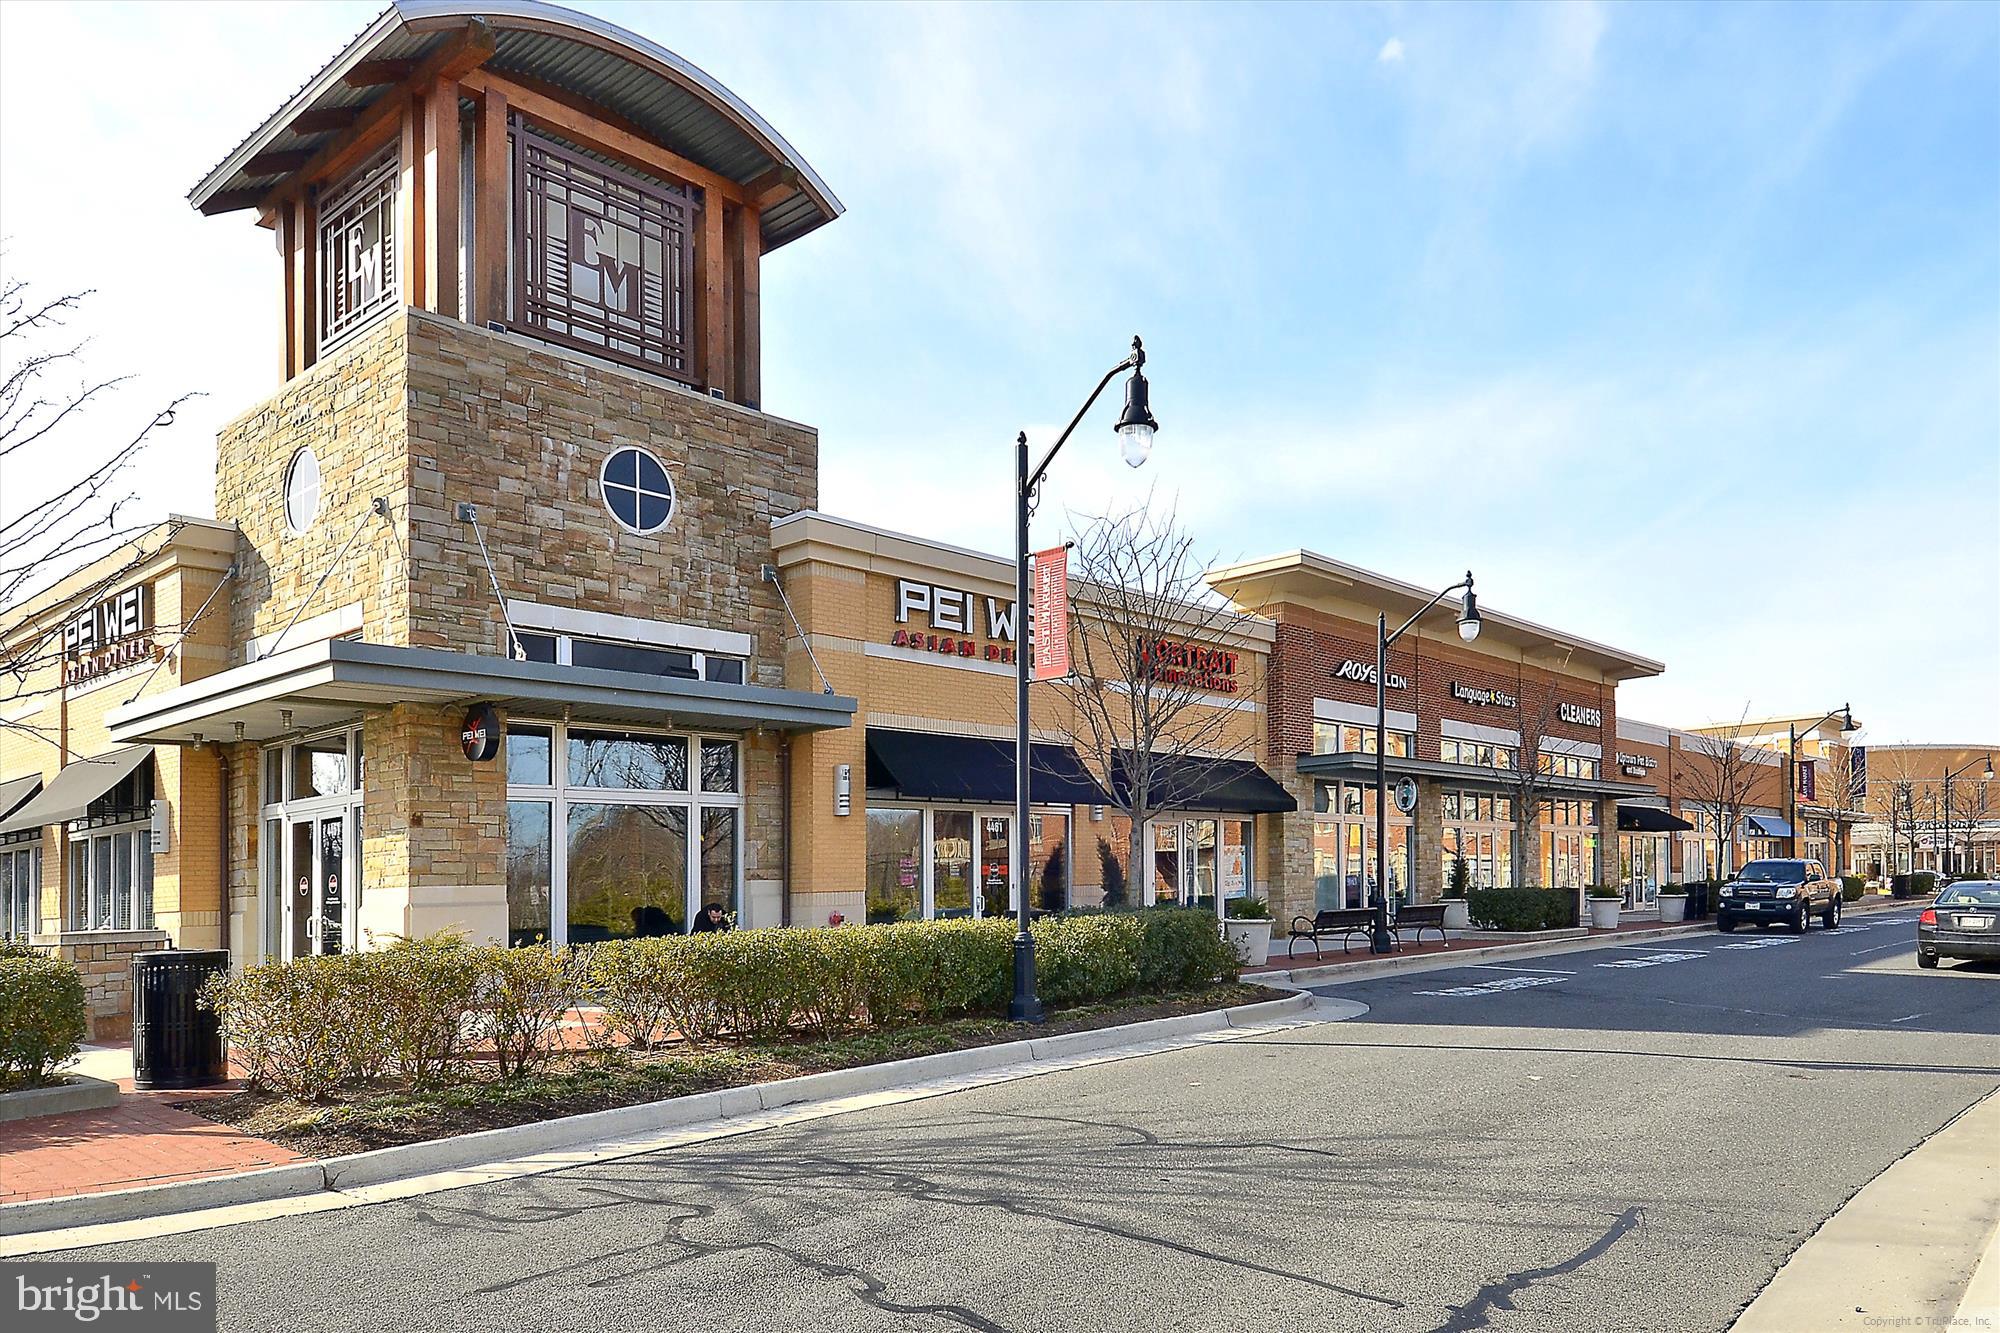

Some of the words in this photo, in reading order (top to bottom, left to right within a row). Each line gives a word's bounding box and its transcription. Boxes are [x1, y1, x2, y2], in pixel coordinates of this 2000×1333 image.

[898, 579, 973, 634] PEI
[64, 607, 98, 662] PEI
[102, 585, 144, 645] WEI
[104, 638, 146, 668] DINER
[894, 629, 976, 657] ASIAN
[1041, 628, 1052, 668] EAST
[1368, 669, 1408, 690] SLON
[1454, 681, 1491, 706] Language
[1495, 690, 1517, 708] Stars
[1560, 702, 1601, 728] CLEANERS
[986, 821, 1003, 834] 4461
